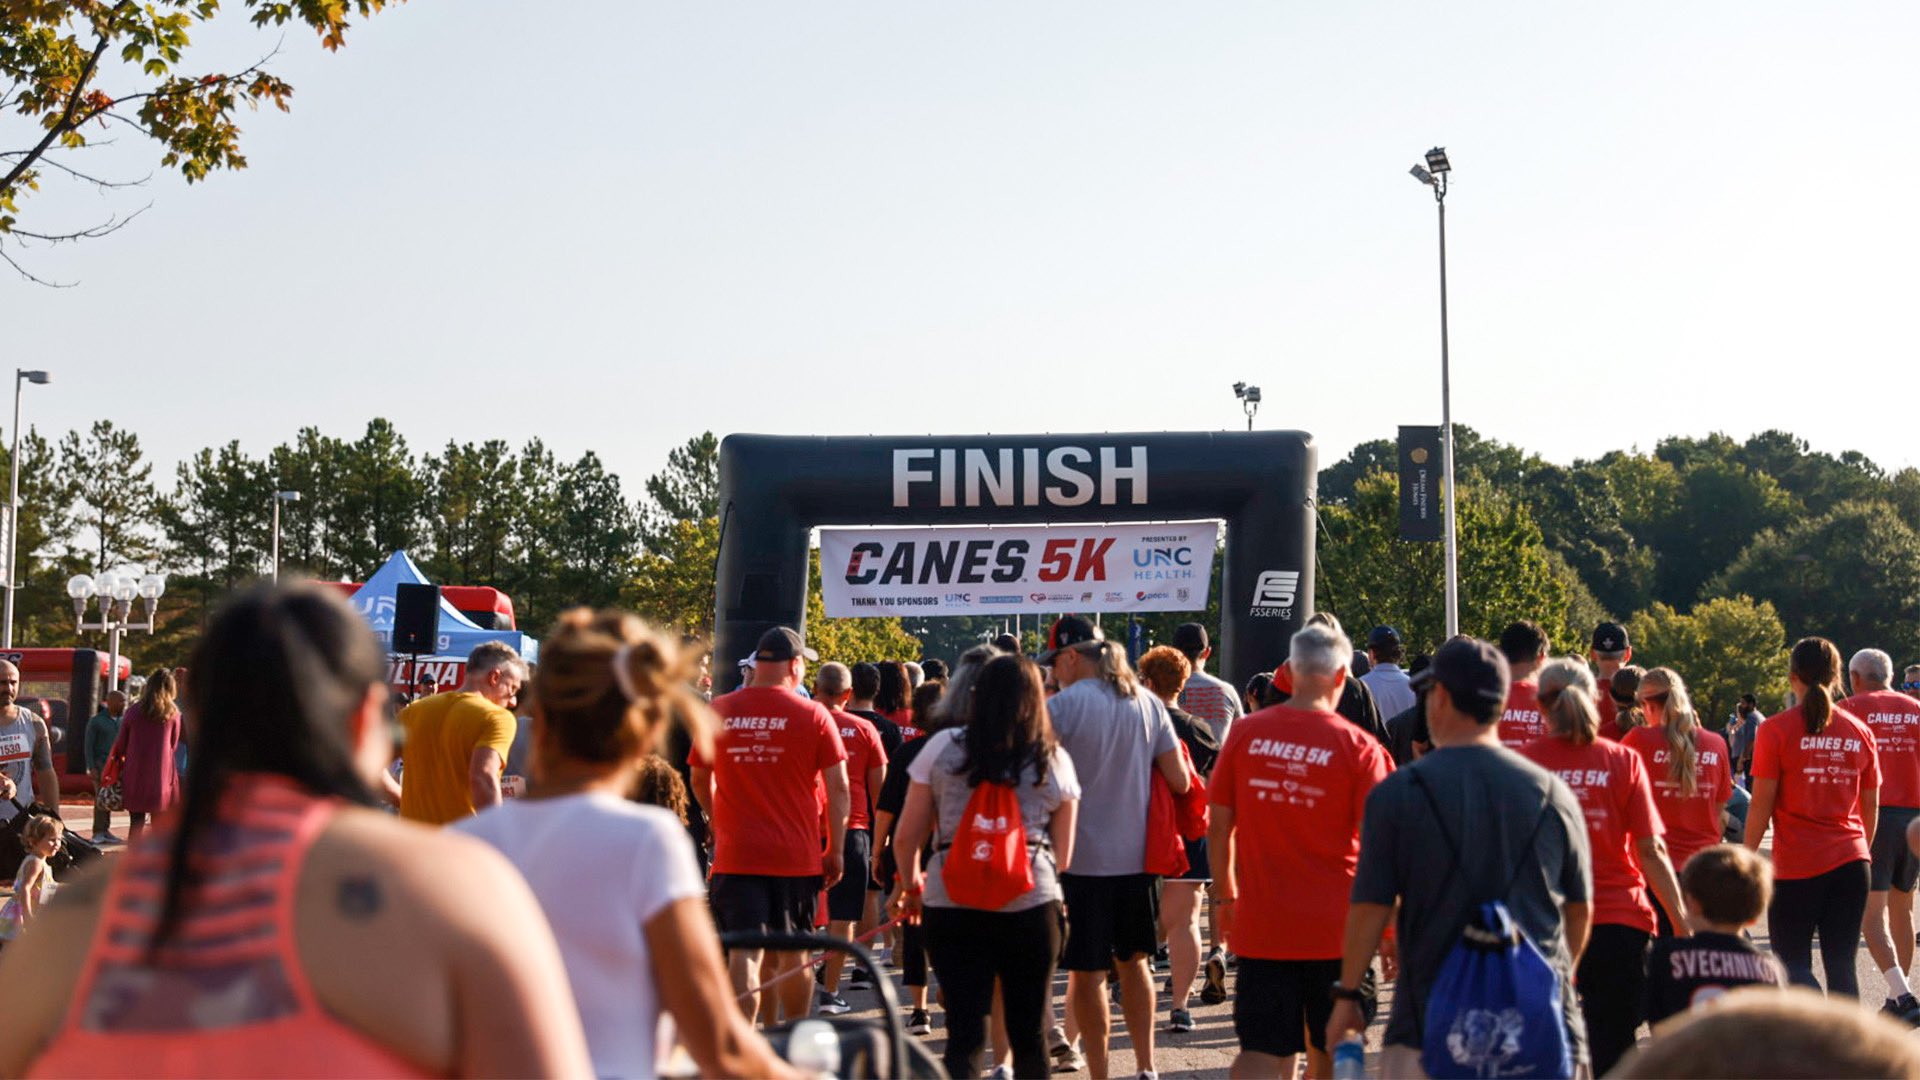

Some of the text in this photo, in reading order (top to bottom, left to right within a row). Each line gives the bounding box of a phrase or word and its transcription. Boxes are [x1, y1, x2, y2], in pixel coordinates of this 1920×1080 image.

[893, 446, 1148, 507] FINISH
[845, 538, 1117, 585] CANES 5K
[1133, 547, 1192, 567] UNC
[1134, 570, 1192, 580] HEALTH
[851, 596, 939, 607] THANK YOU SPONSORS
[1250, 607, 1292, 618] FSSERIES
[724, 717, 788, 730] CANES 5K
[1501, 709, 1540, 723] ANES
[1867, 713, 1920, 725] CANES 5K
[1800, 737, 1861, 752] CANES 5K
[1248, 739, 1333, 767] CANES 5K
[1701, 751, 1719, 766] 5K
[1585, 769, 1610, 787] 5K
